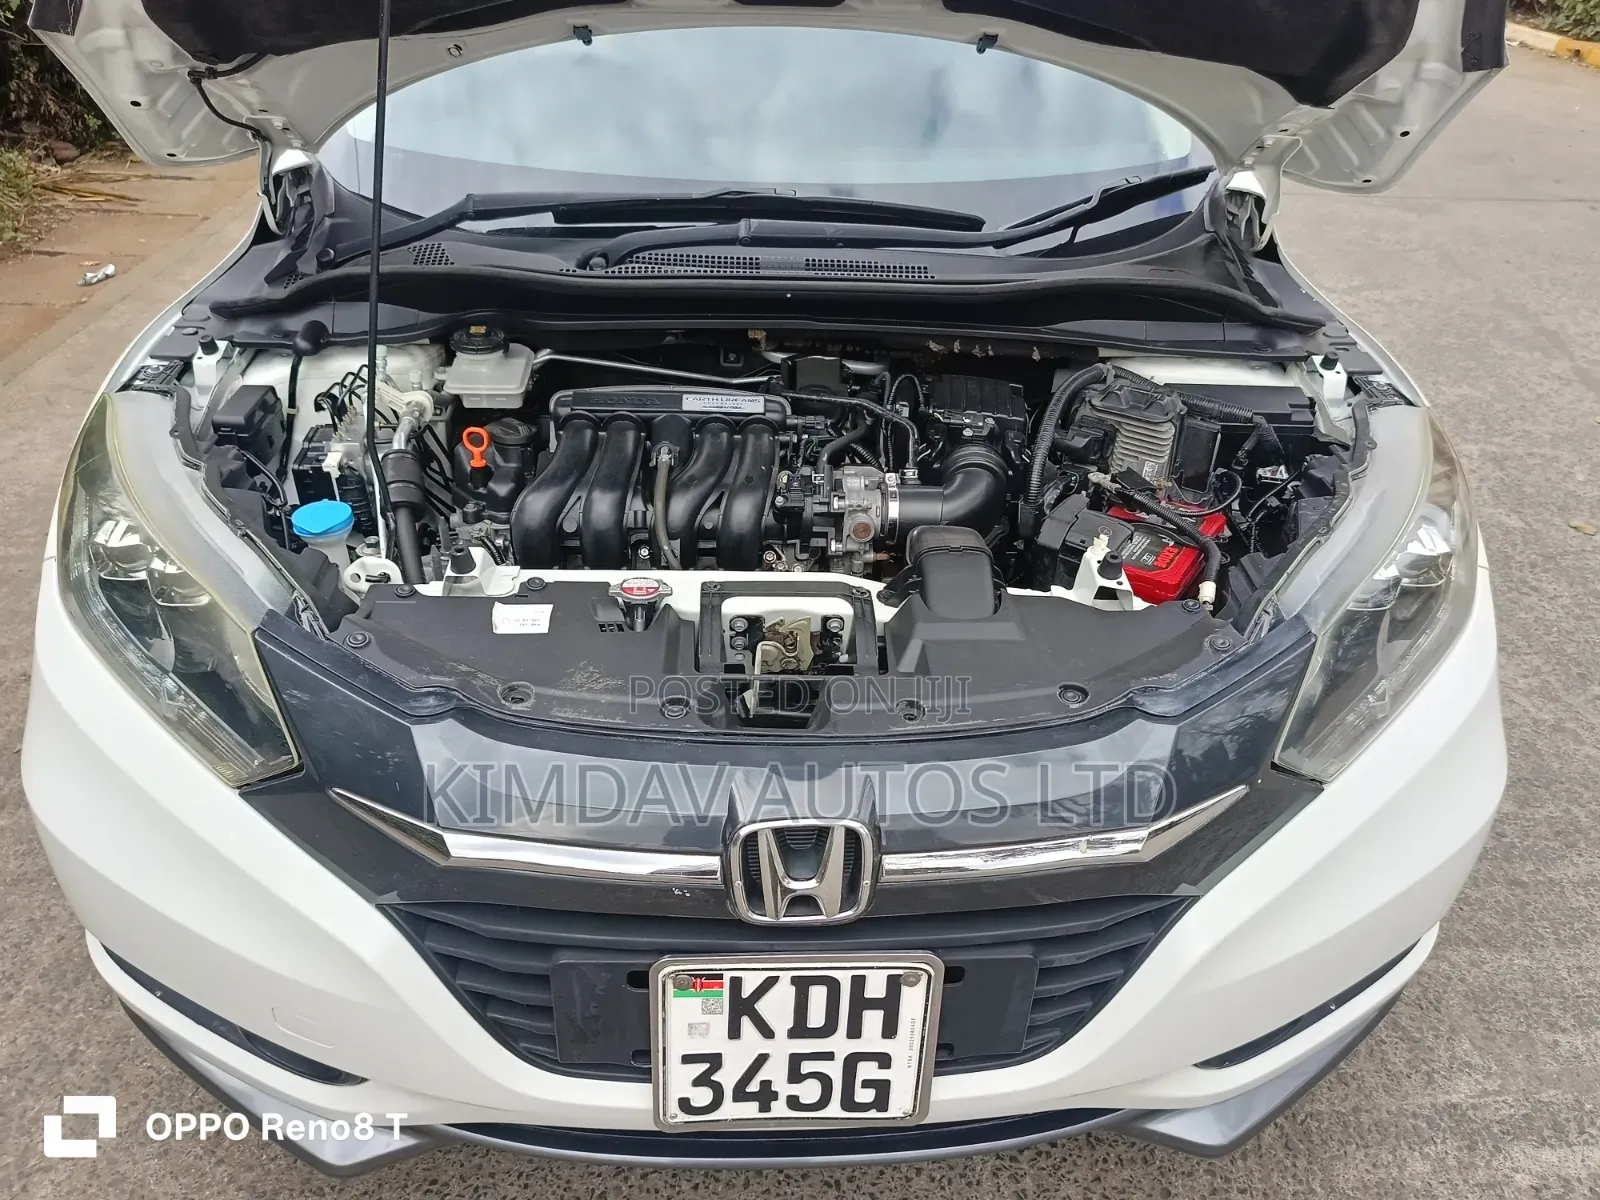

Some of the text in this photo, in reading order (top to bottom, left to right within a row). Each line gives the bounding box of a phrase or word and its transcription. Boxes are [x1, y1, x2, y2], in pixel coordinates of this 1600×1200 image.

[1153, 546, 1180, 569] EXIDE
[727, 973, 903, 1037] KDH
[677, 1051, 892, 1116] 345G
